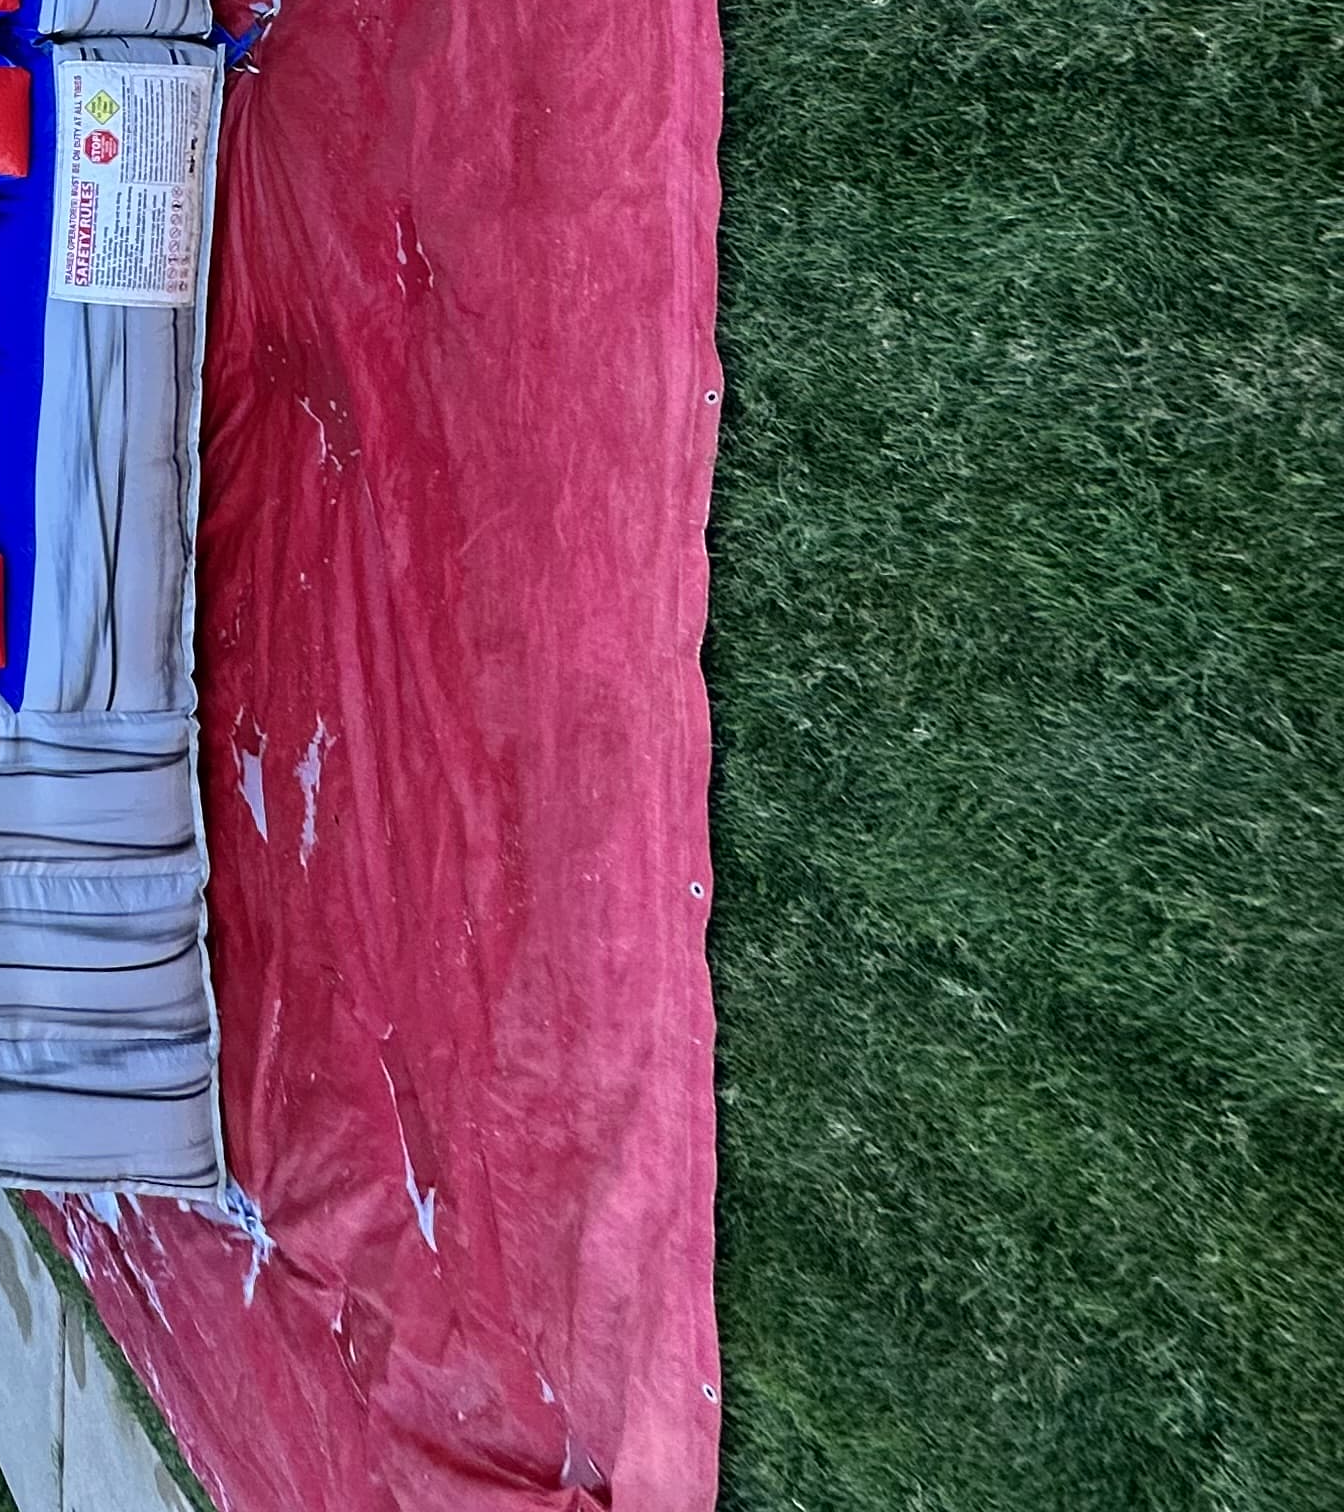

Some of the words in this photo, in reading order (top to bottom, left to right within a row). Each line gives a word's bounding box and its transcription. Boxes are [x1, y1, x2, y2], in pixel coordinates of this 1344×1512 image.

[75, 117, 81, 125] AT
[73, 150, 80, 160] ON
[80, 183, 93, 227] RULES
[76, 231, 90, 285] SAFETY
